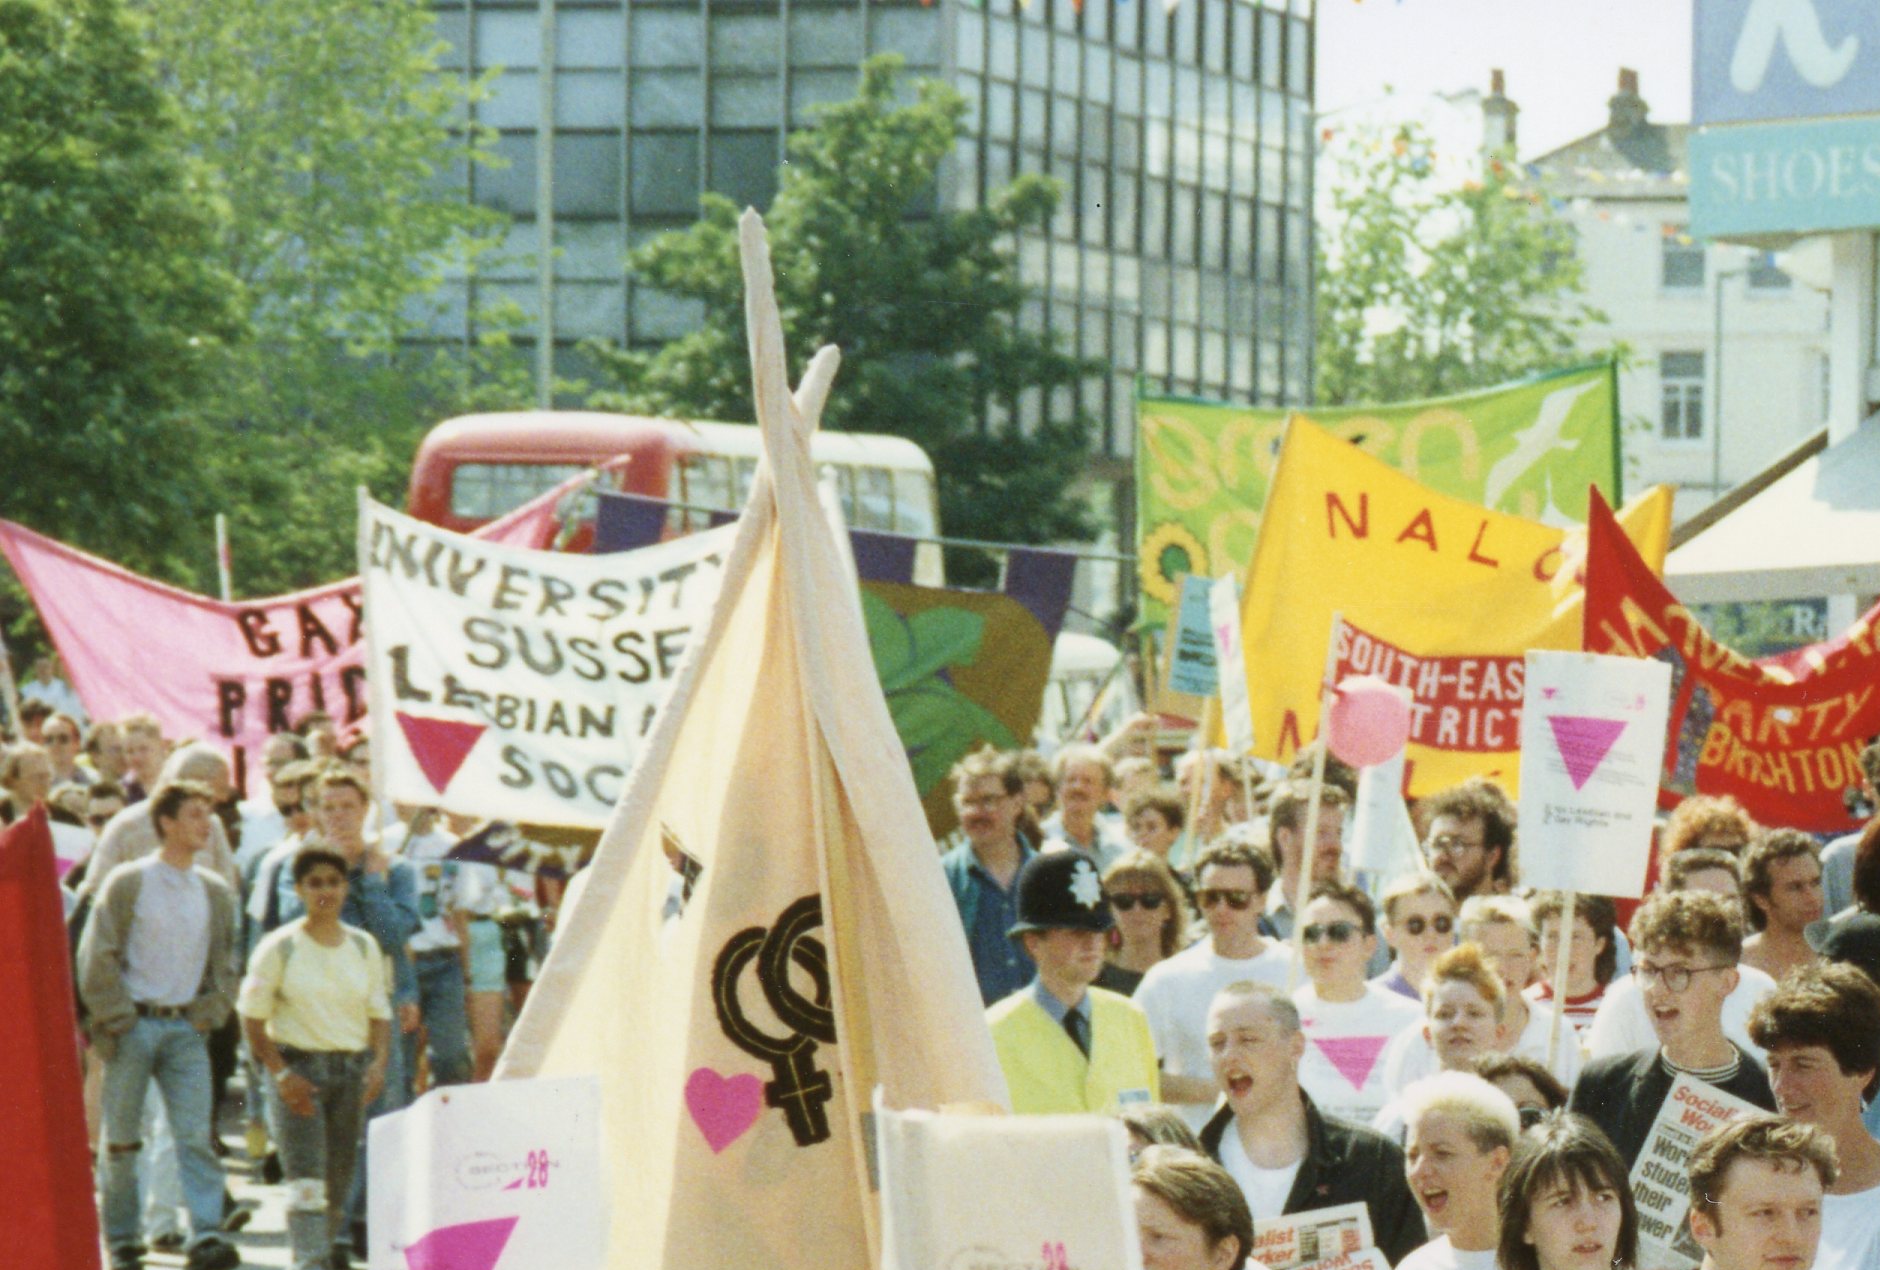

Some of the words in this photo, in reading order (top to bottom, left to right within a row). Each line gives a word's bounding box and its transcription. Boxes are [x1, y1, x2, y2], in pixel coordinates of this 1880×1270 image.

[369, 519, 722, 622] UNIVERSIT
[238, 593, 363, 658] GAY
[388, 645, 616, 738] LEBIAN
[499, 743, 624, 807] SOC
[527, 1149, 549, 1189] 28
